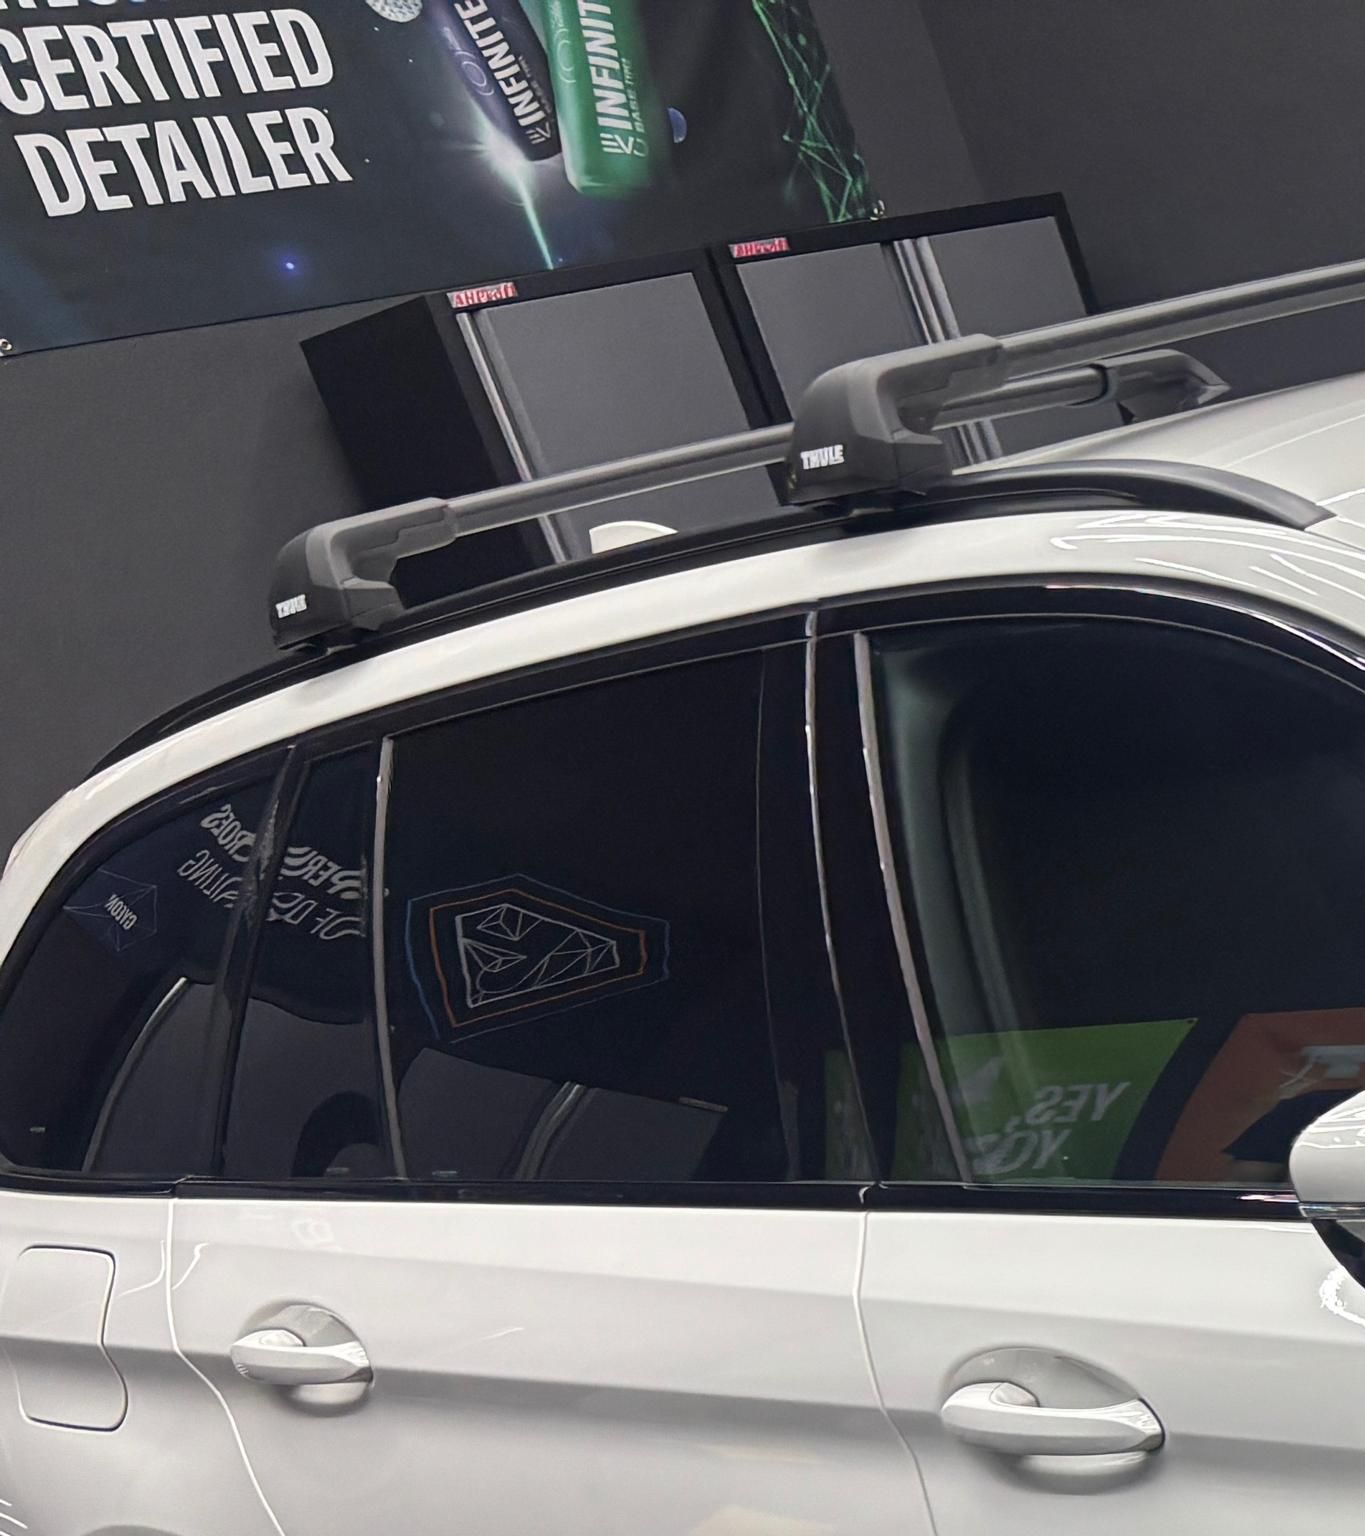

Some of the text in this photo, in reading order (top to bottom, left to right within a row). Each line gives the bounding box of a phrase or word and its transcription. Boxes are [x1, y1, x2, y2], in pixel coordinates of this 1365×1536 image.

[0, 8, 333, 115] CERTIFIED
[13, 106, 353, 217] DETAILER
[800, 444, 845, 470] THULE
